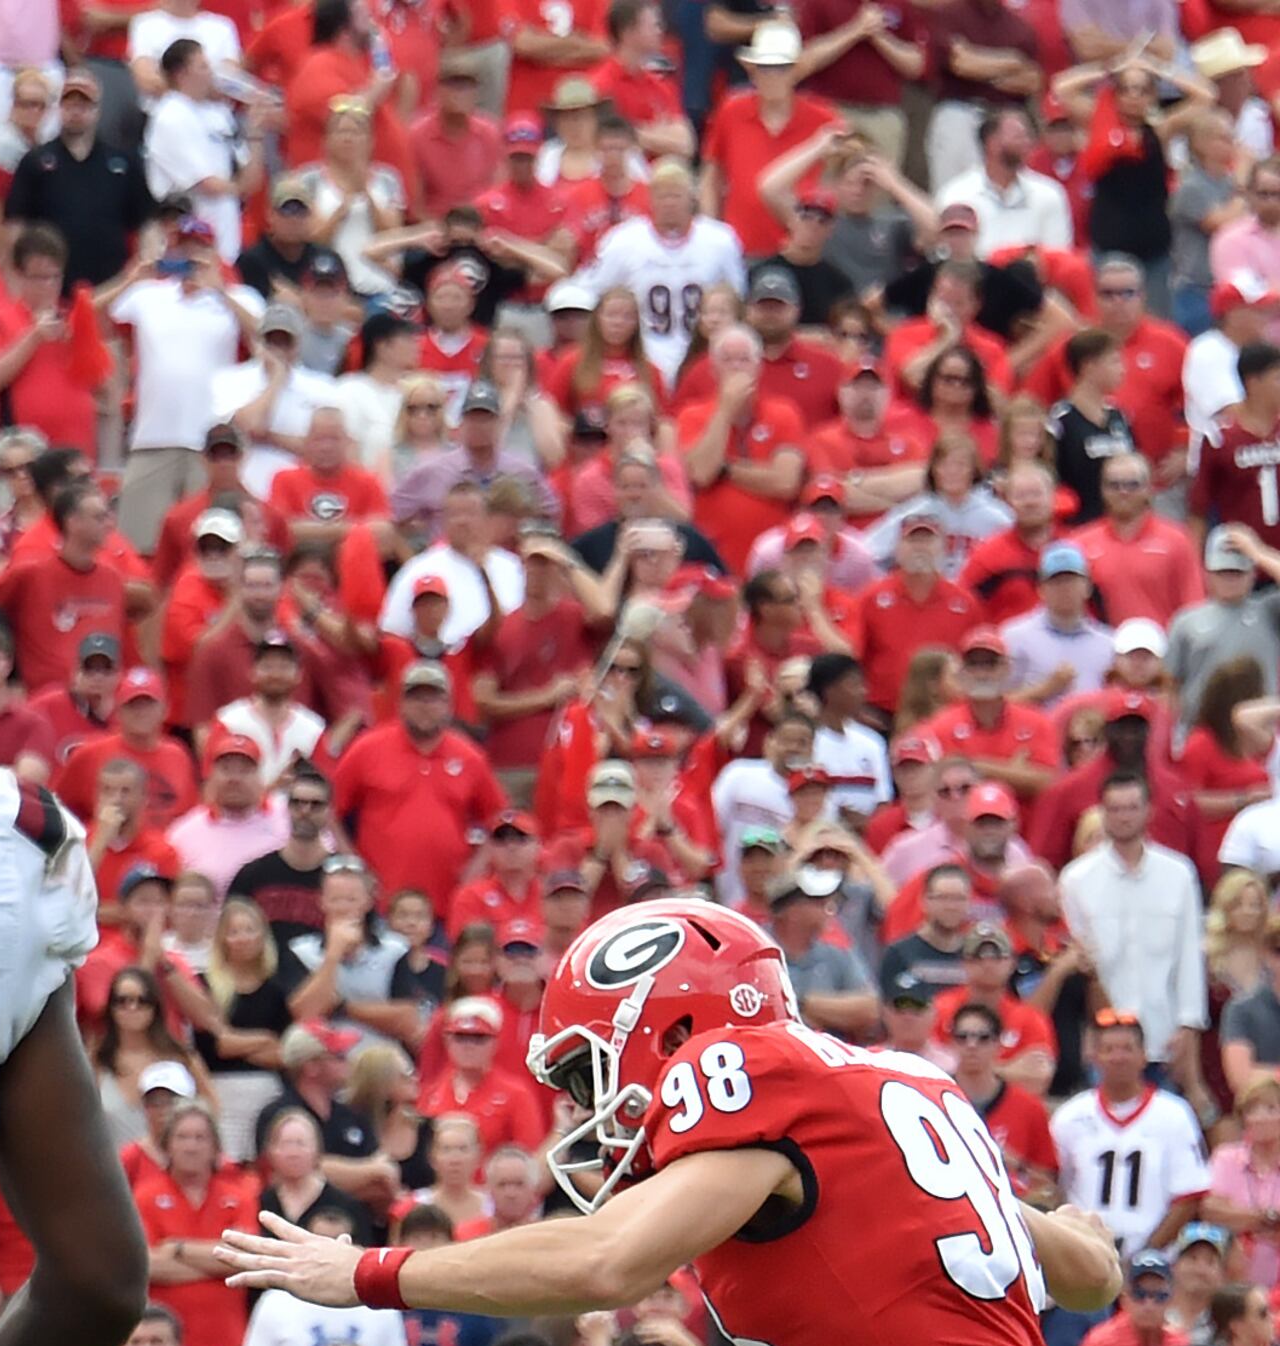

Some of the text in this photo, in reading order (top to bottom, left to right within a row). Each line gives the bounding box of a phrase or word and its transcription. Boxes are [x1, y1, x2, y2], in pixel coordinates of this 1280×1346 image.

[660, 1040, 753, 1134] 98
[880, 1079, 1046, 1316] 98
[1098, 1149, 1142, 1208] 11
